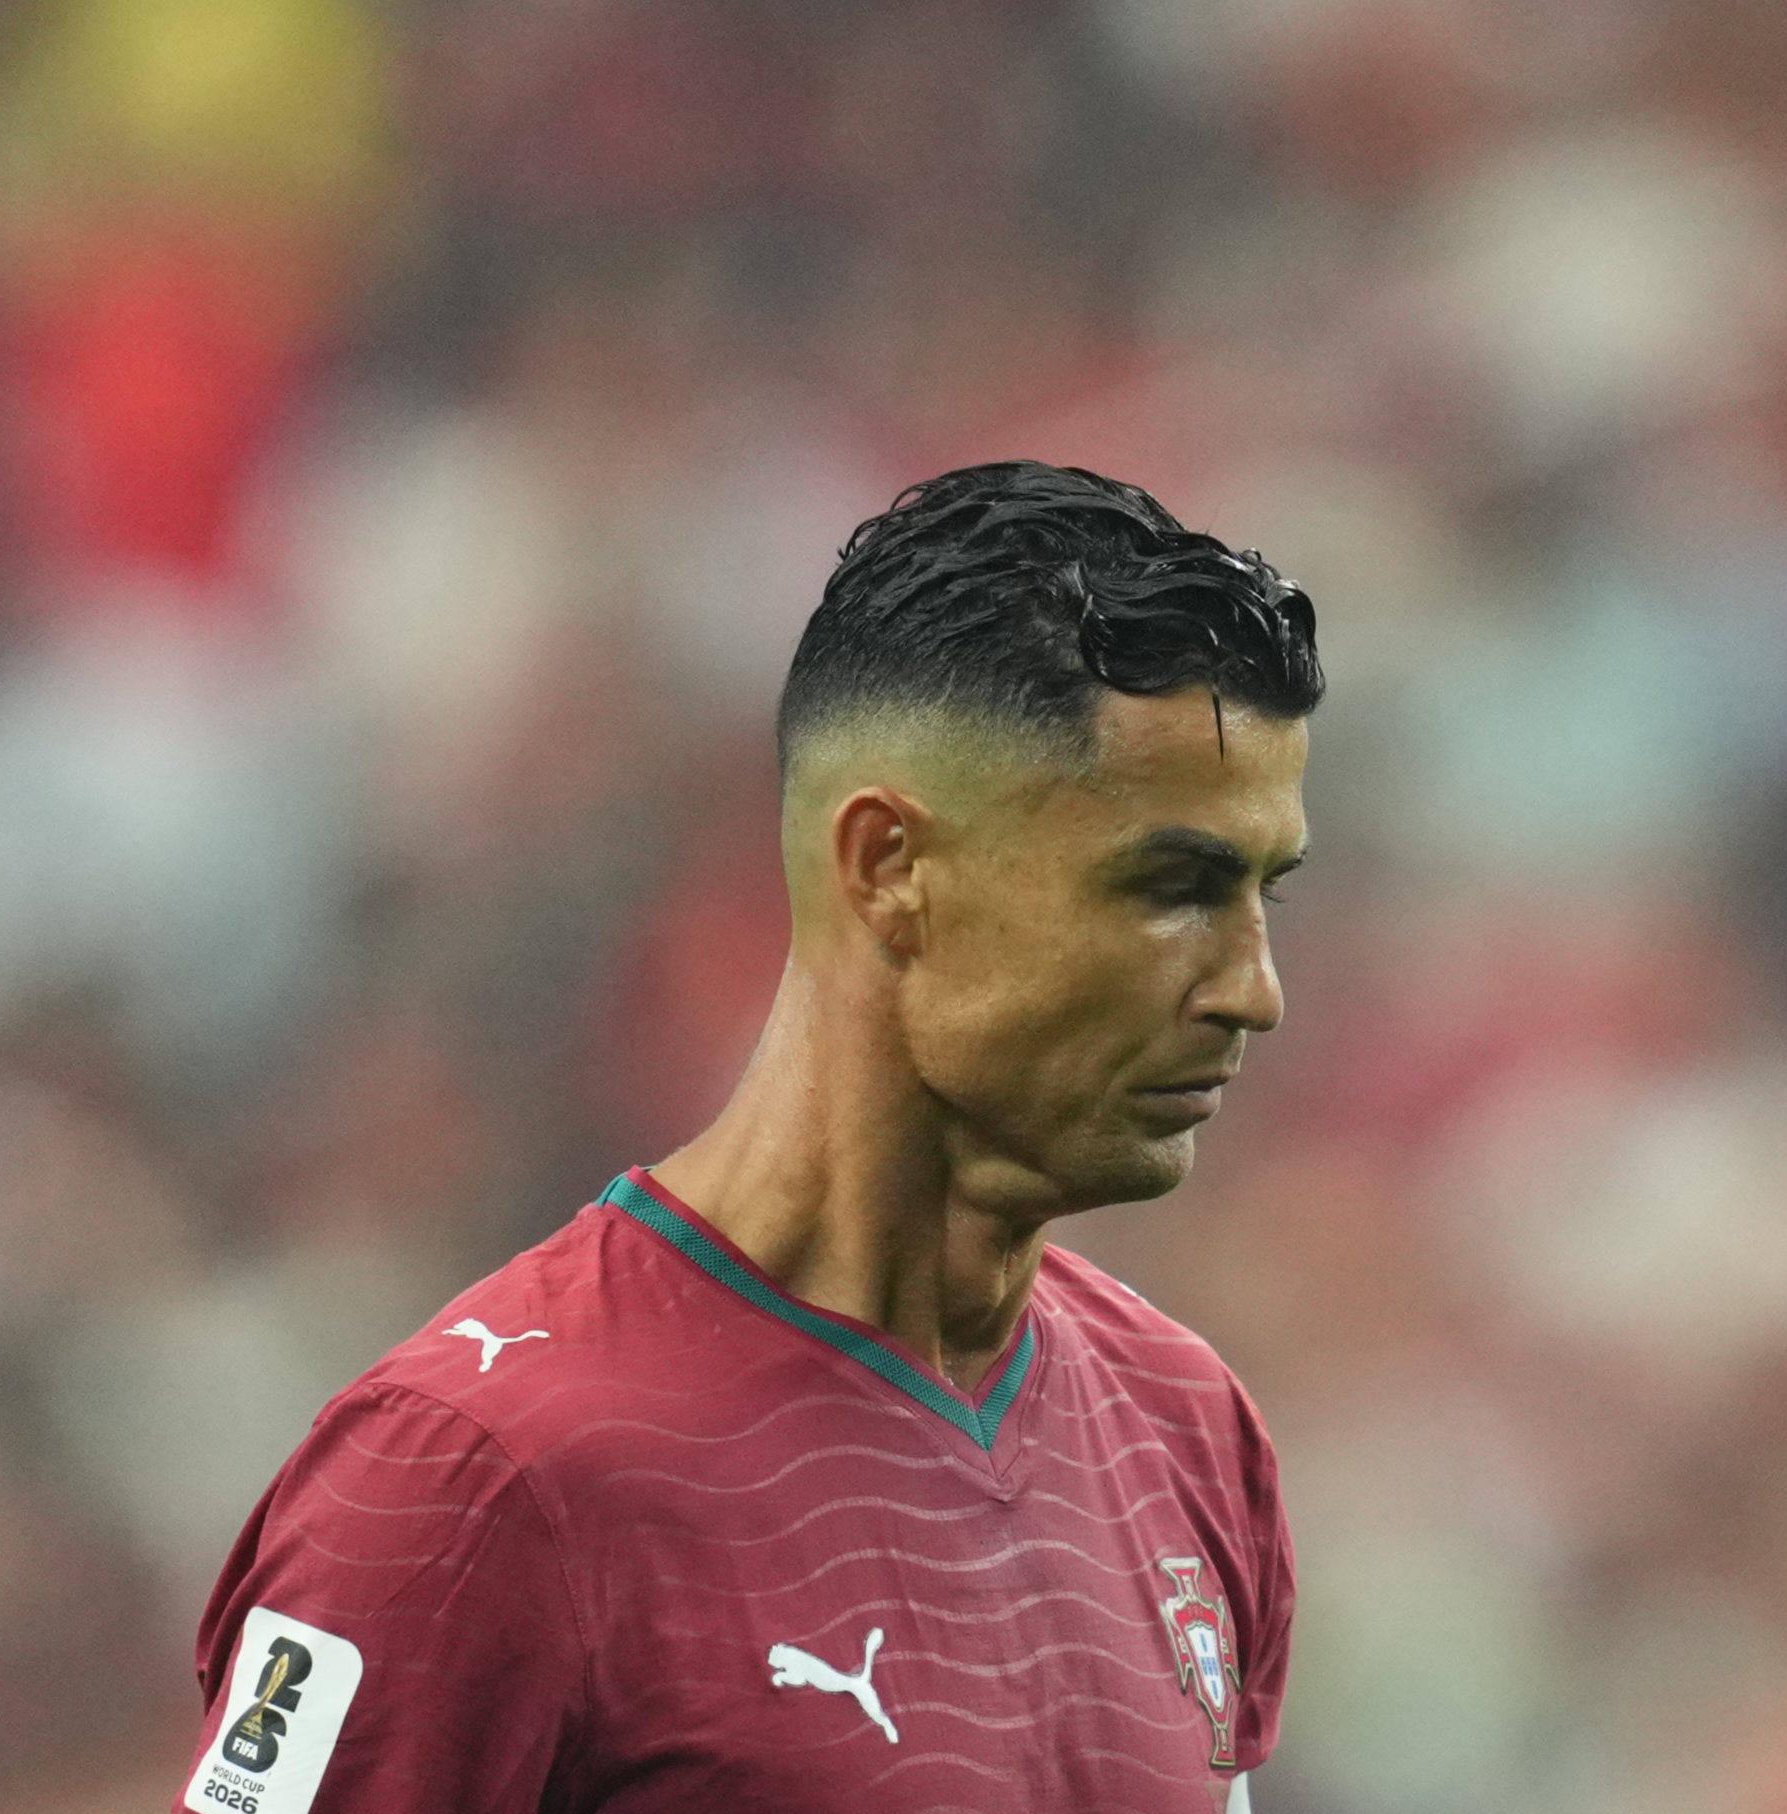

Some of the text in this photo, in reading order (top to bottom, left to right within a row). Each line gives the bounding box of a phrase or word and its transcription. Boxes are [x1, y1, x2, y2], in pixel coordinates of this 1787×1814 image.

[232, 1737, 259, 1760] FIFA
[213, 1764, 265, 1794] WORLD CUP
